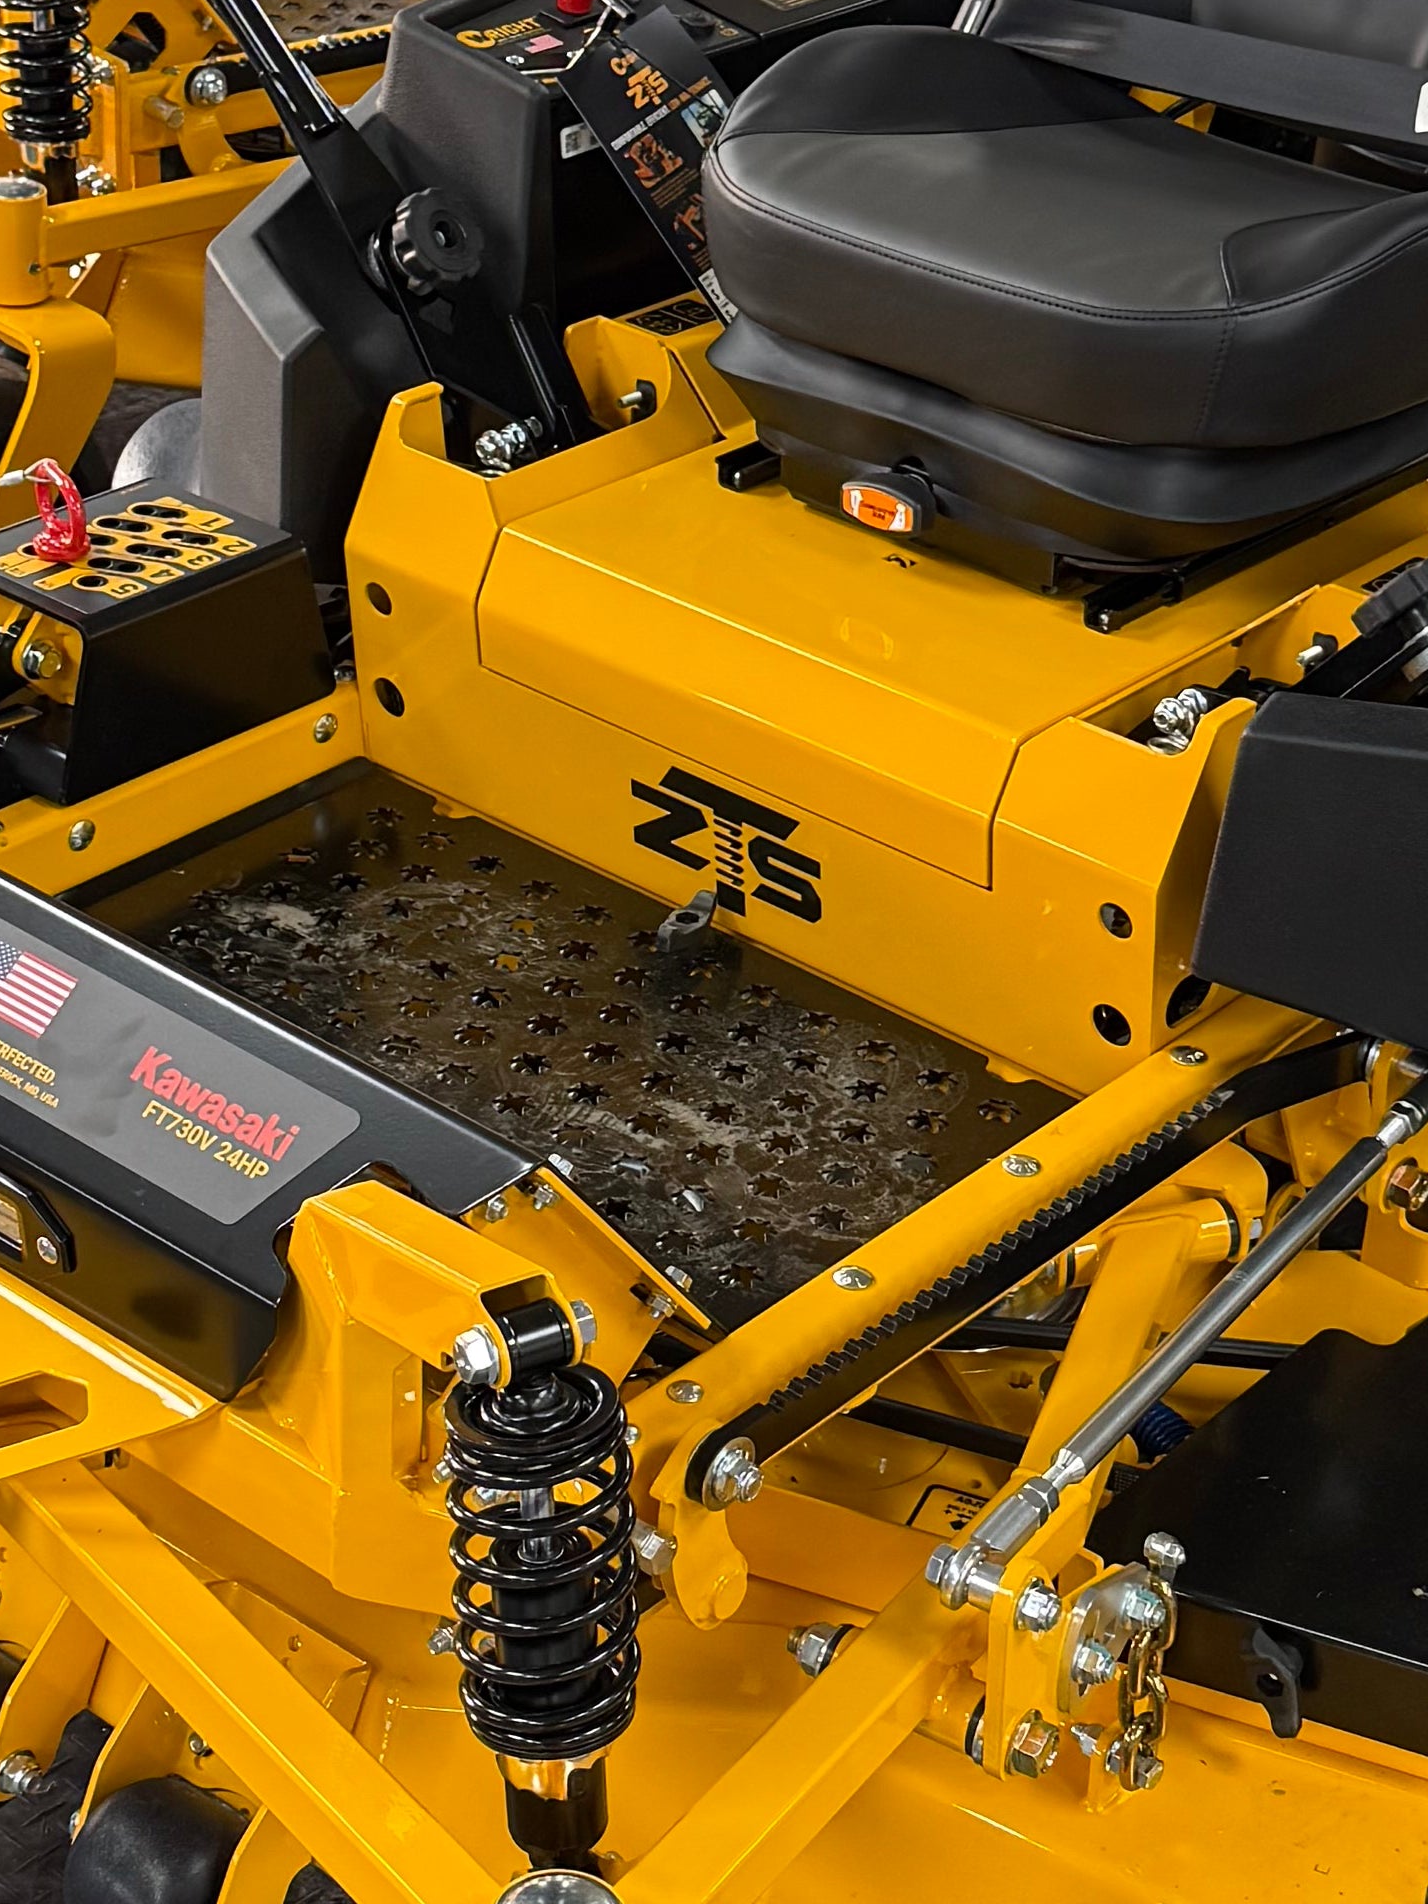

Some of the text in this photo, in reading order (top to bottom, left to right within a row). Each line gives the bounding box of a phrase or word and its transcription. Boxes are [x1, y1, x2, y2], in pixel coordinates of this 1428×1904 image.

[456, 17, 542, 48] WRIGHT
[188, 554, 215, 569] 3
[148, 567, 175, 580] 4
[110, 583, 140, 597] 5
[41, 1091, 61, 1108] USA
[129, 1045, 301, 1162] Kawasaki
[141, 1099, 270, 1179] FT730V 24HP
